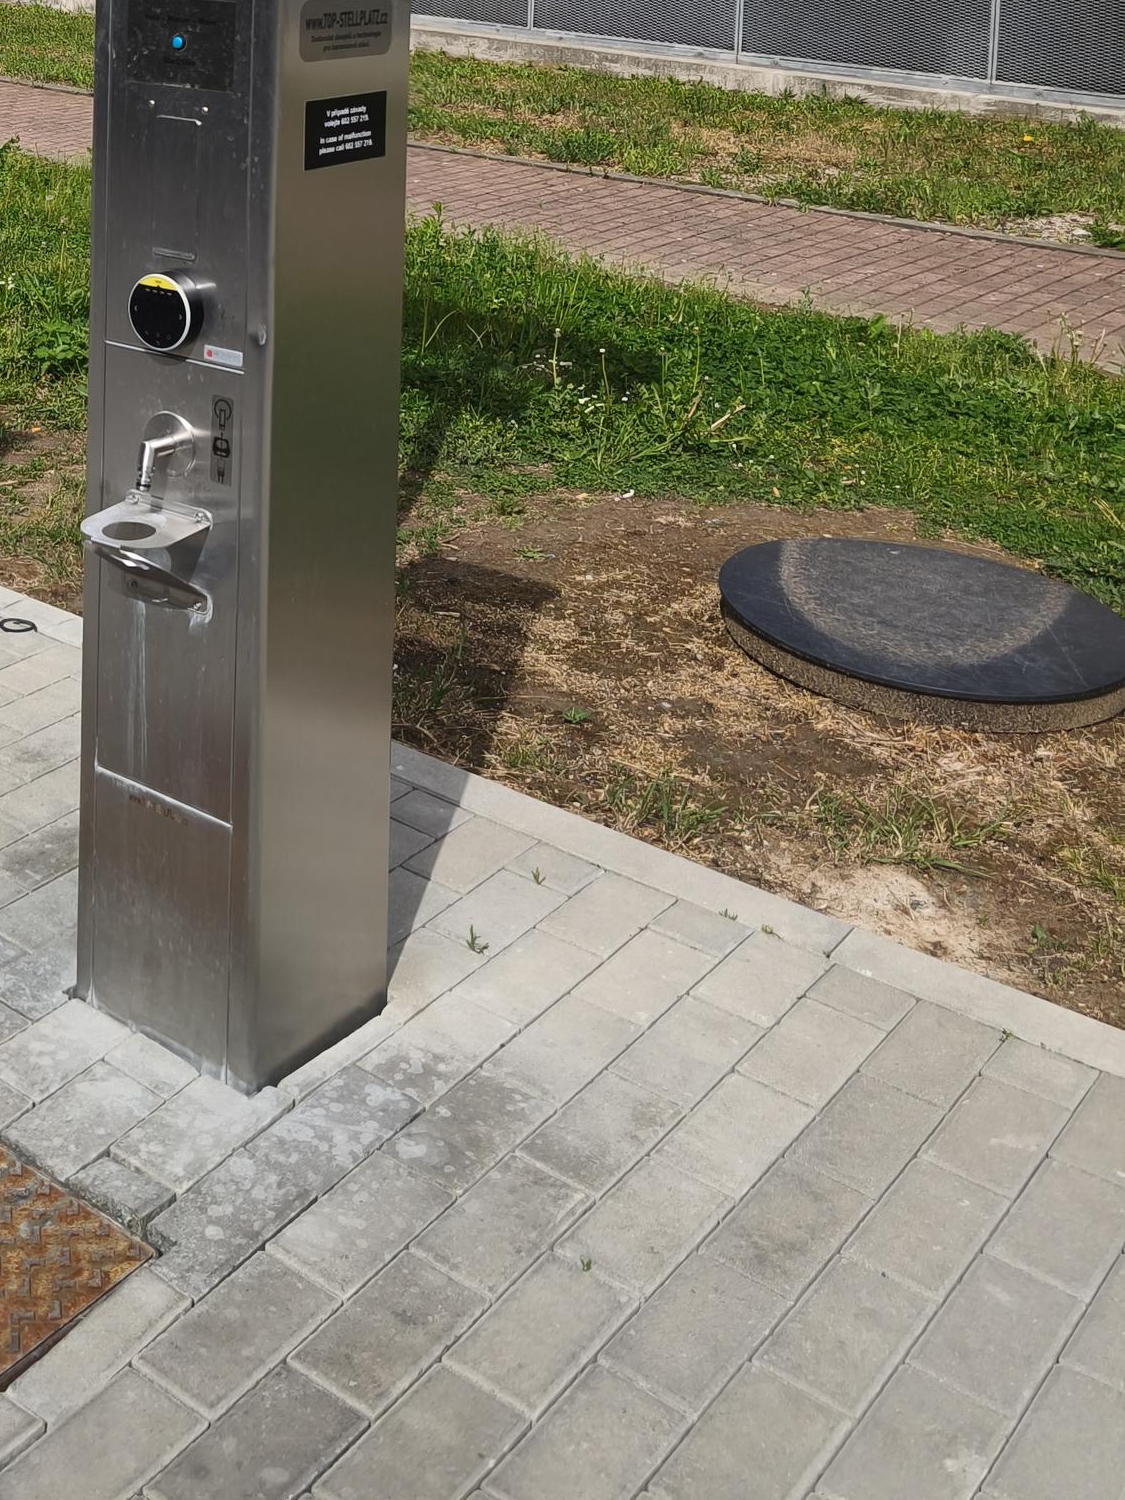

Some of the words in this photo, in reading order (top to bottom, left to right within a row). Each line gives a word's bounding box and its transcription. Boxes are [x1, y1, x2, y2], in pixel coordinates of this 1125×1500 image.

[326, 110, 331, 118] V
[325, 136, 337, 144] case
[338, 133, 344, 141] of
[319, 146, 336, 156] please
[336, 143, 344, 152] call
